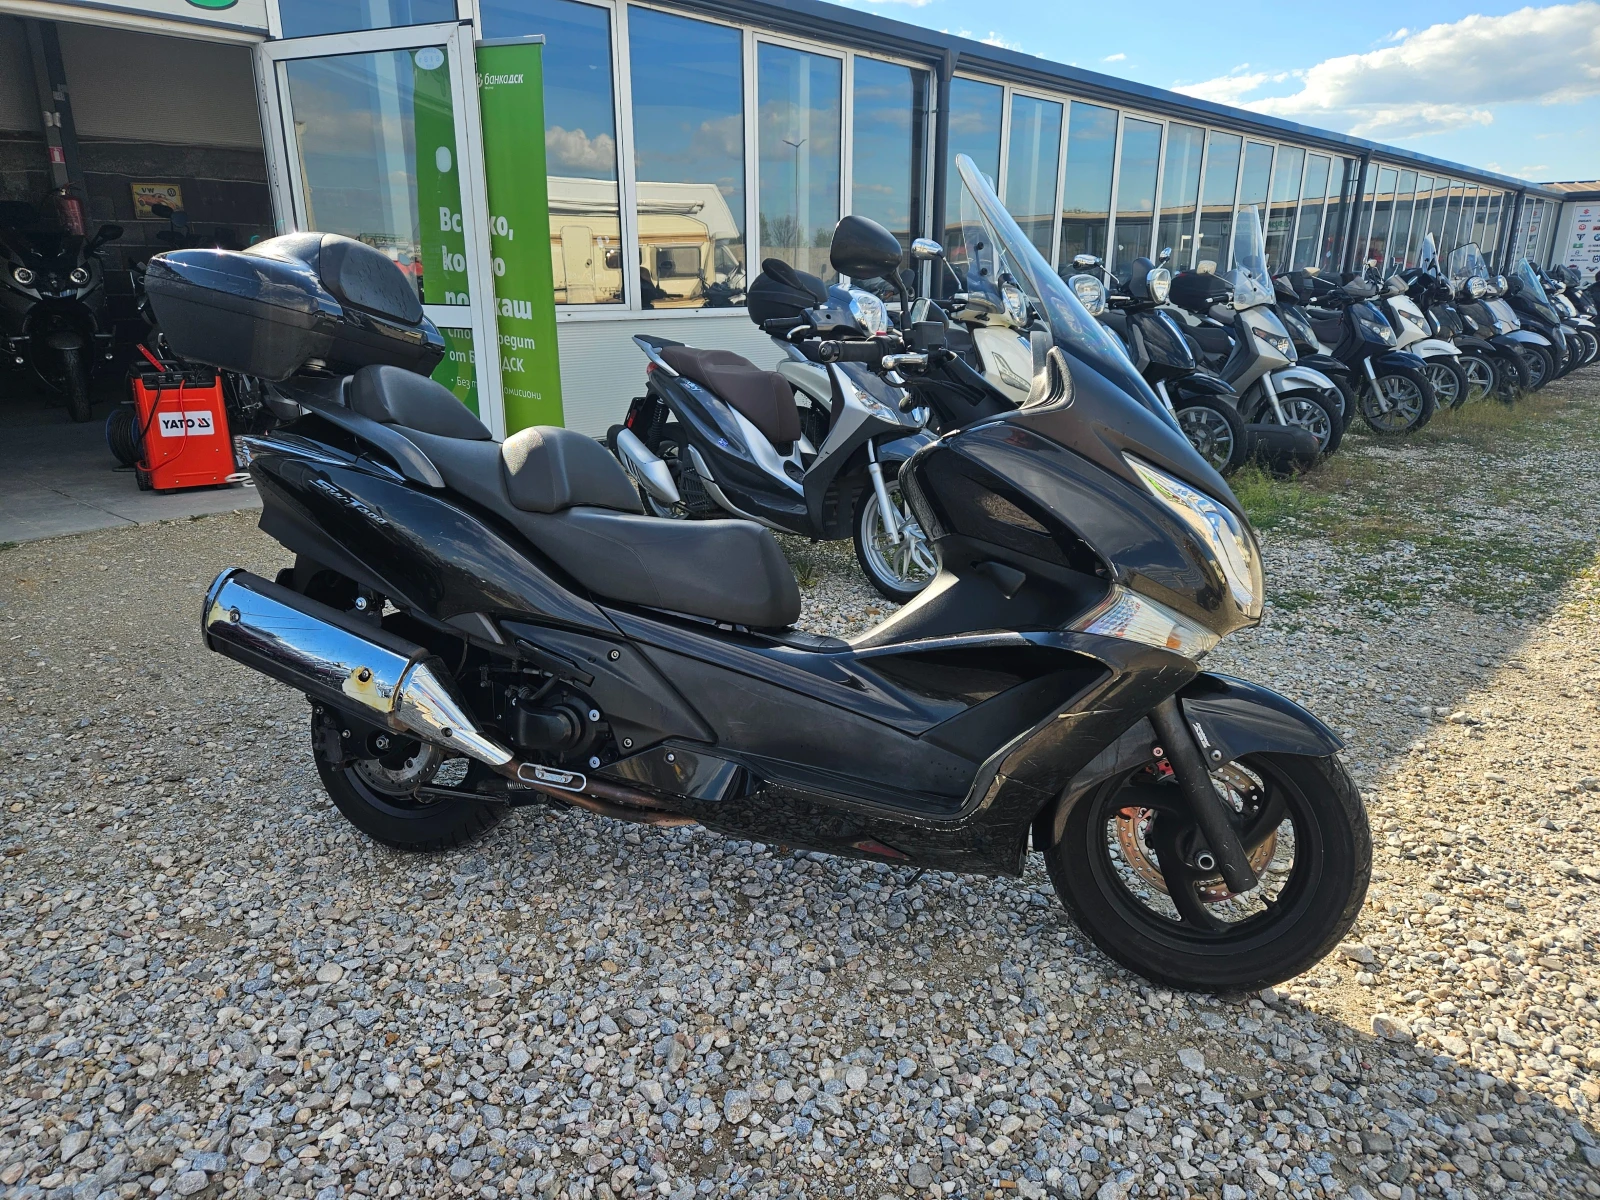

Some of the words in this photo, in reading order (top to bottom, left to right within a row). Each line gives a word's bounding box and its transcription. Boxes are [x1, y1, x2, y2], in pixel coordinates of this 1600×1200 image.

[439, 207, 514, 240] Вско,
[442, 245, 506, 277] коо
[498, 334, 536, 351] редит
[503, 386, 542, 400] омисиони
[162, 418, 195, 429] YATO
